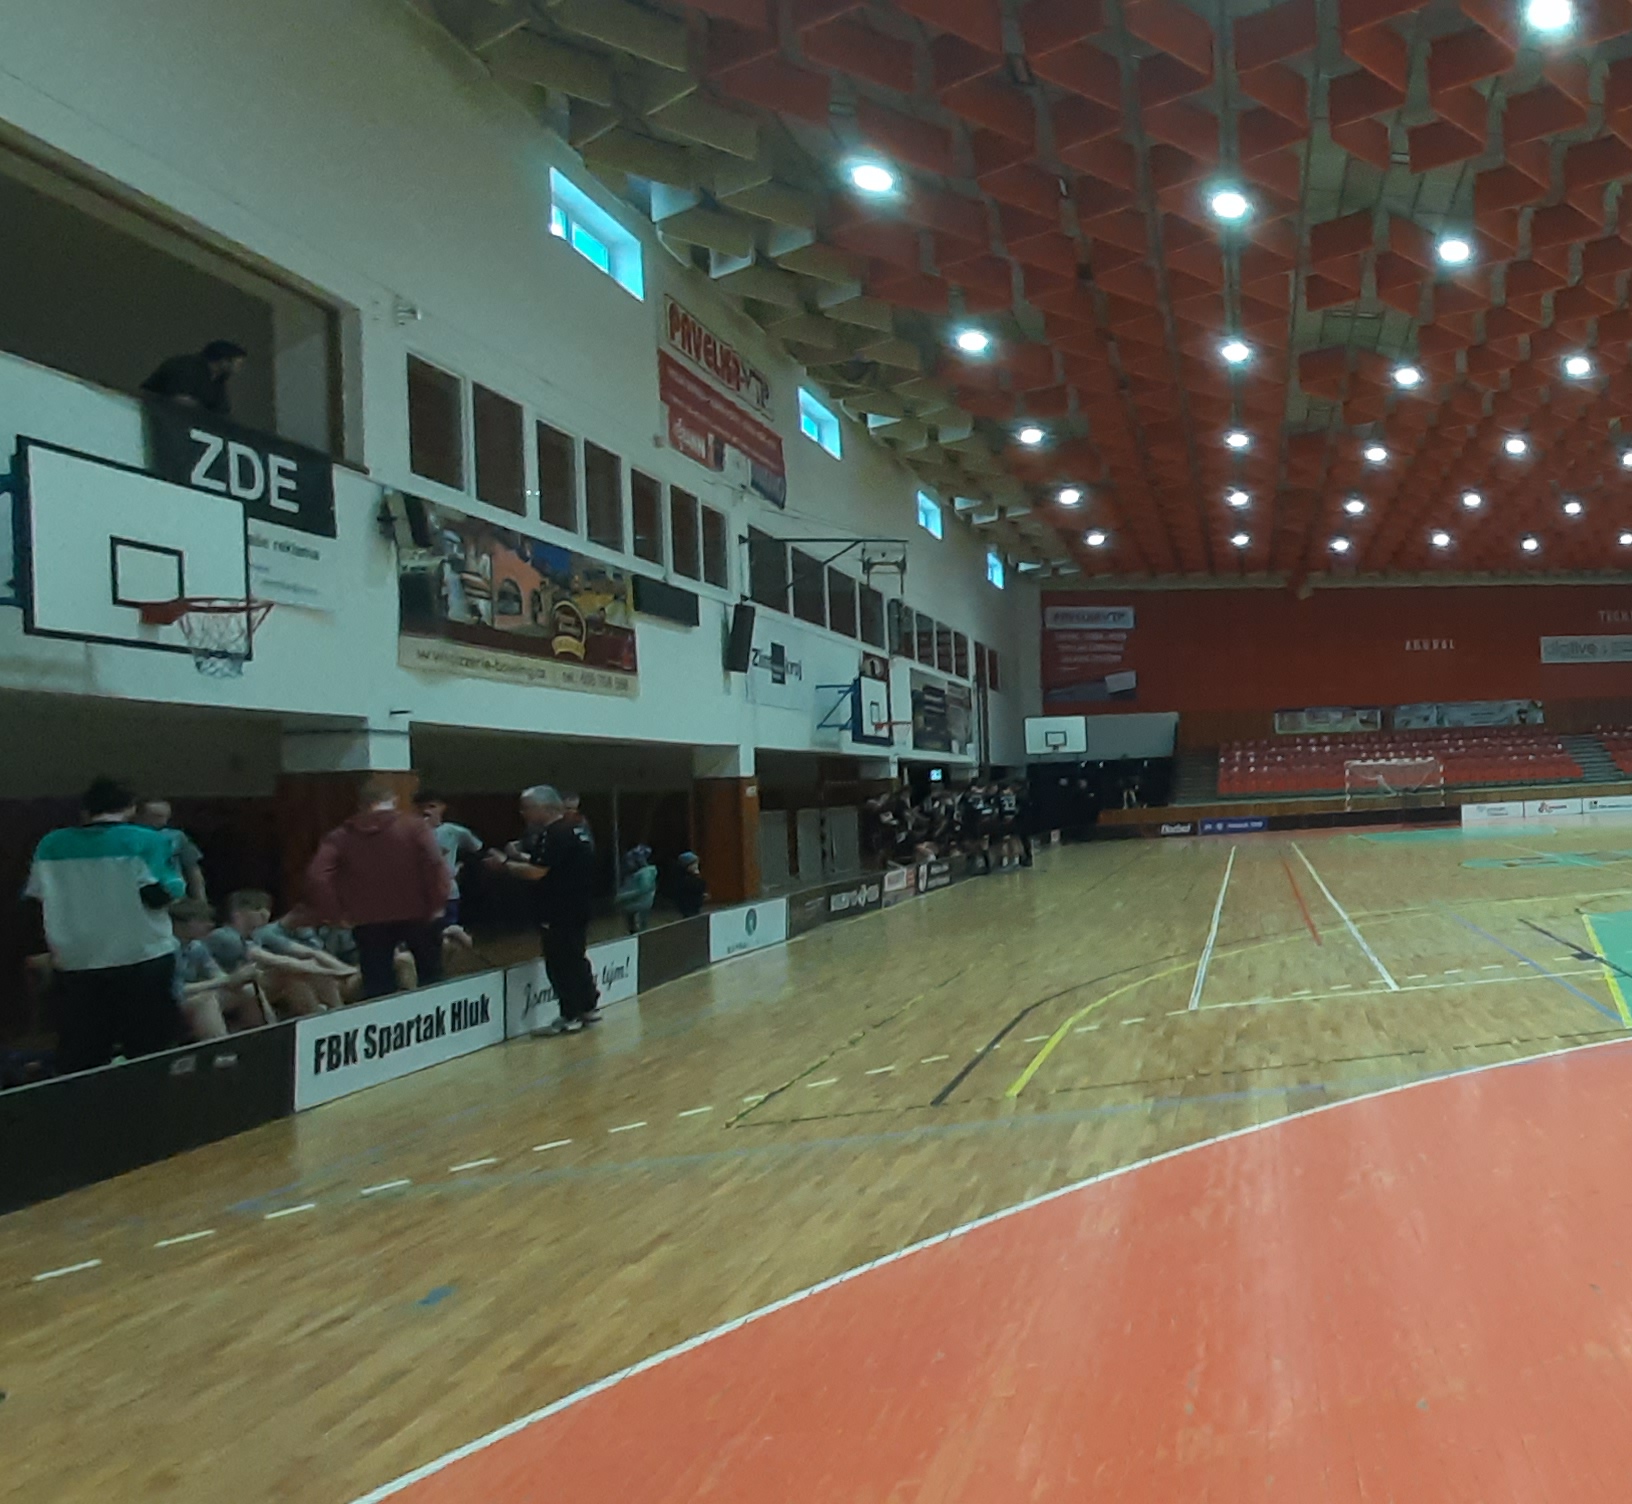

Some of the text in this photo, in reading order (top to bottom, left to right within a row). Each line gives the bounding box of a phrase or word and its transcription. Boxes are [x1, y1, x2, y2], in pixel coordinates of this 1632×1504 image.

[190, 428, 299, 513] ZDE
[314, 993, 490, 1075] FBK Spartak Hluk
